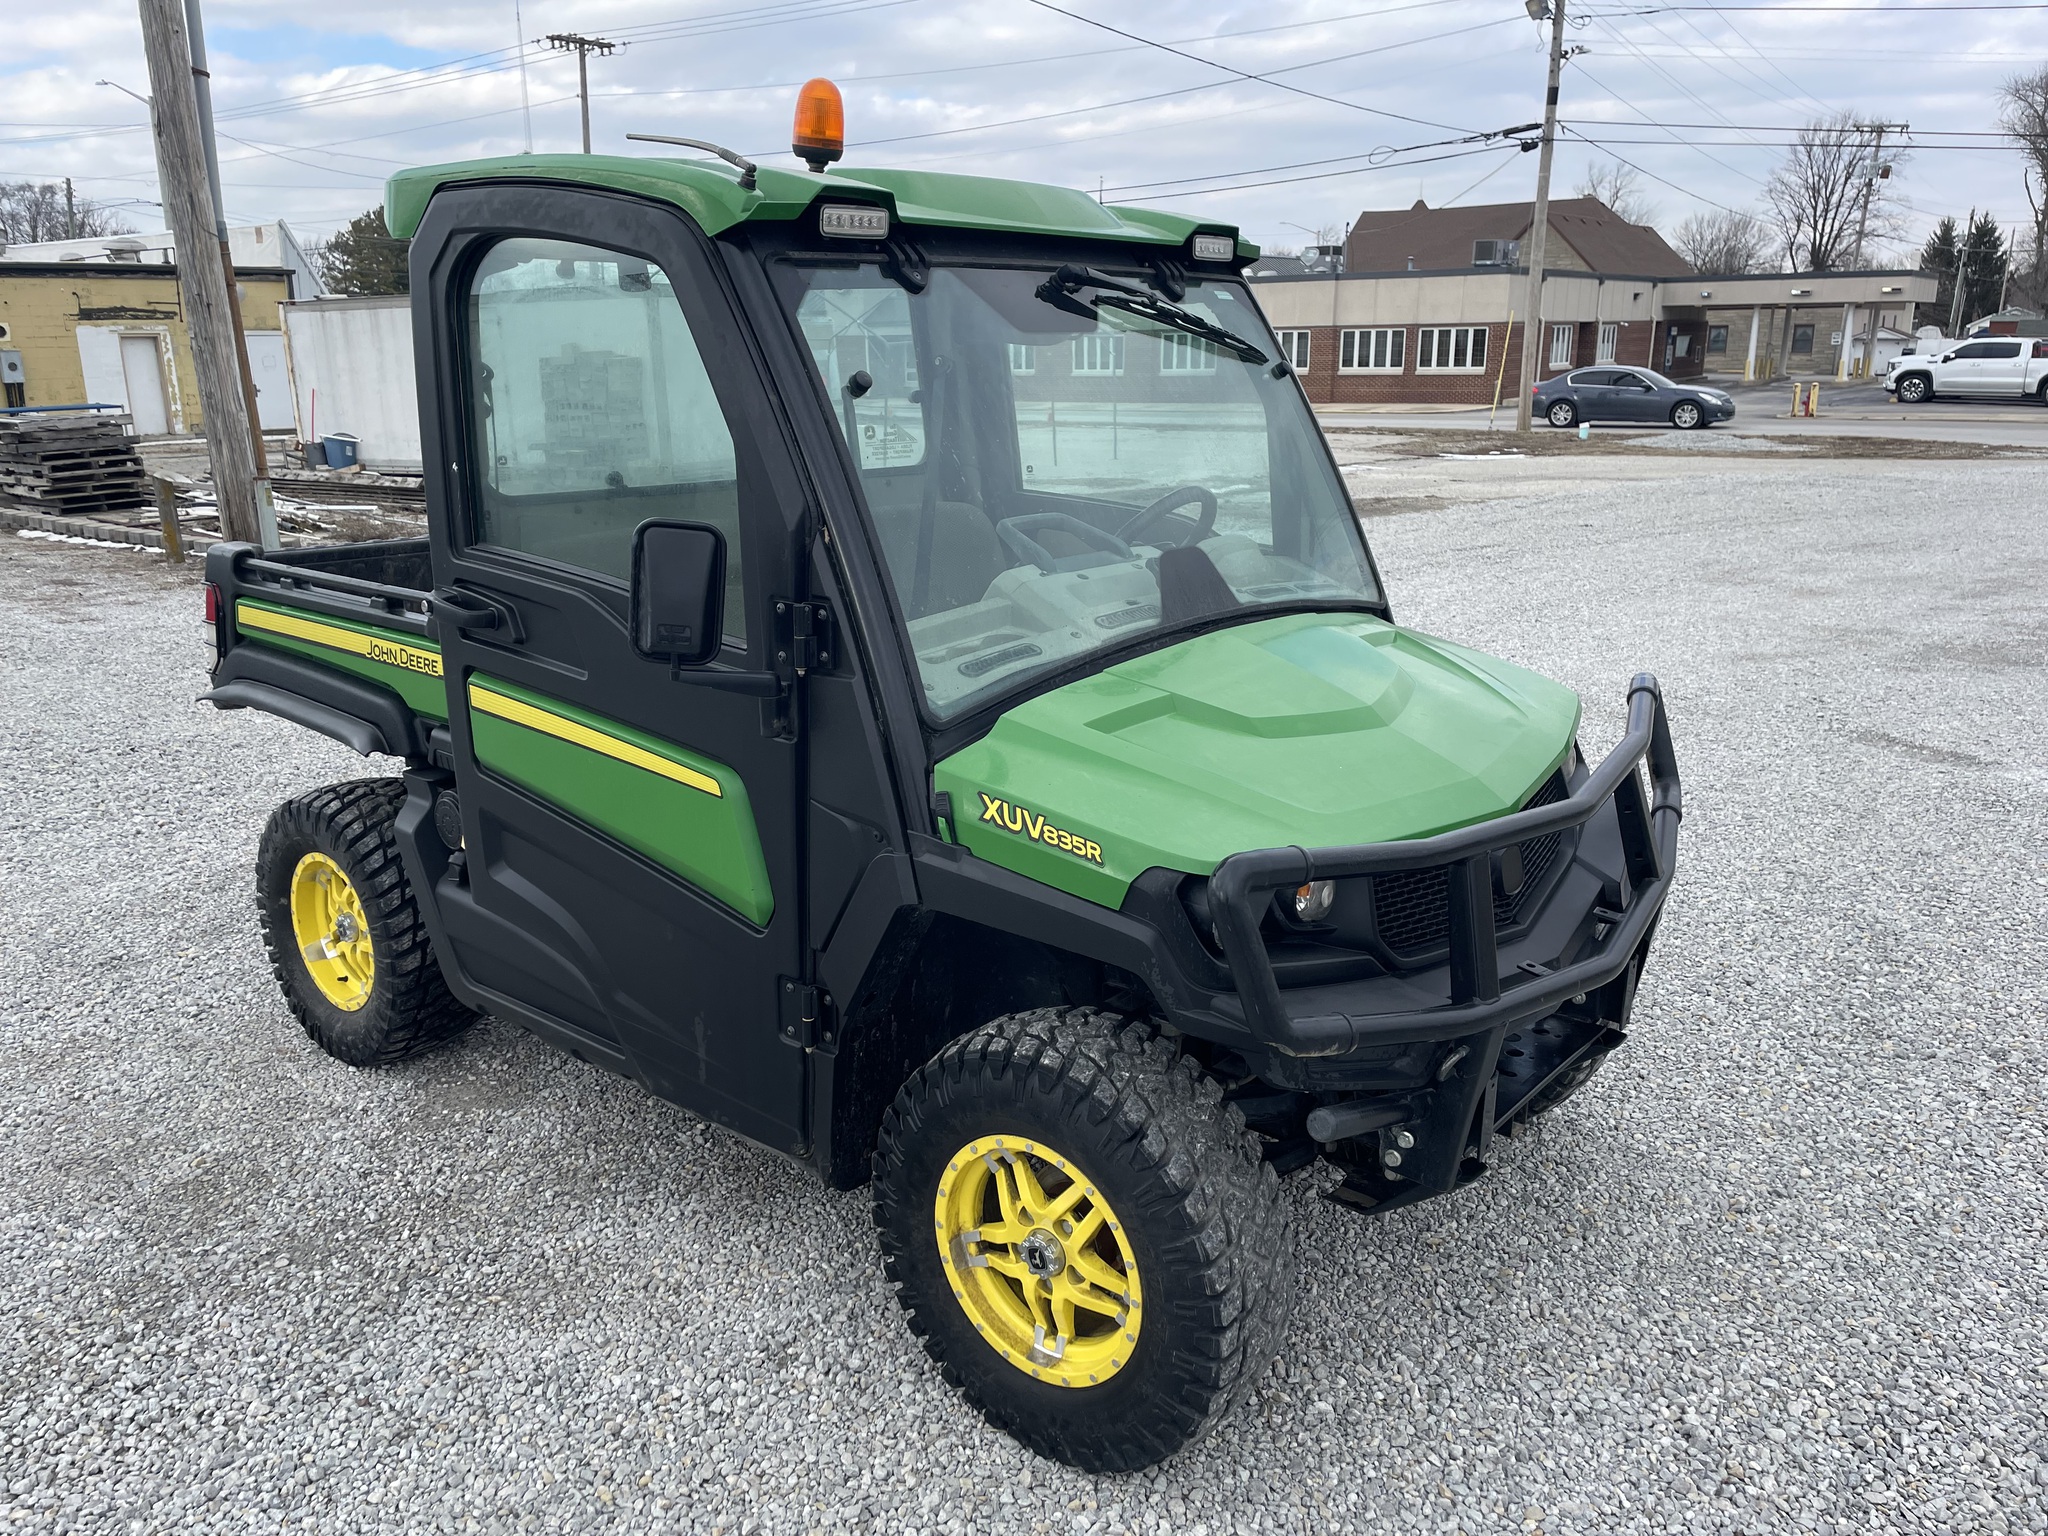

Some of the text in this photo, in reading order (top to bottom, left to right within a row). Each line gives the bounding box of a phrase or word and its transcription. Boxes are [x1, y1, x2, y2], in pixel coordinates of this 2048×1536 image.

[367, 640, 439, 674] JOHN DEERE
[979, 792, 1104, 866] XUV835R
